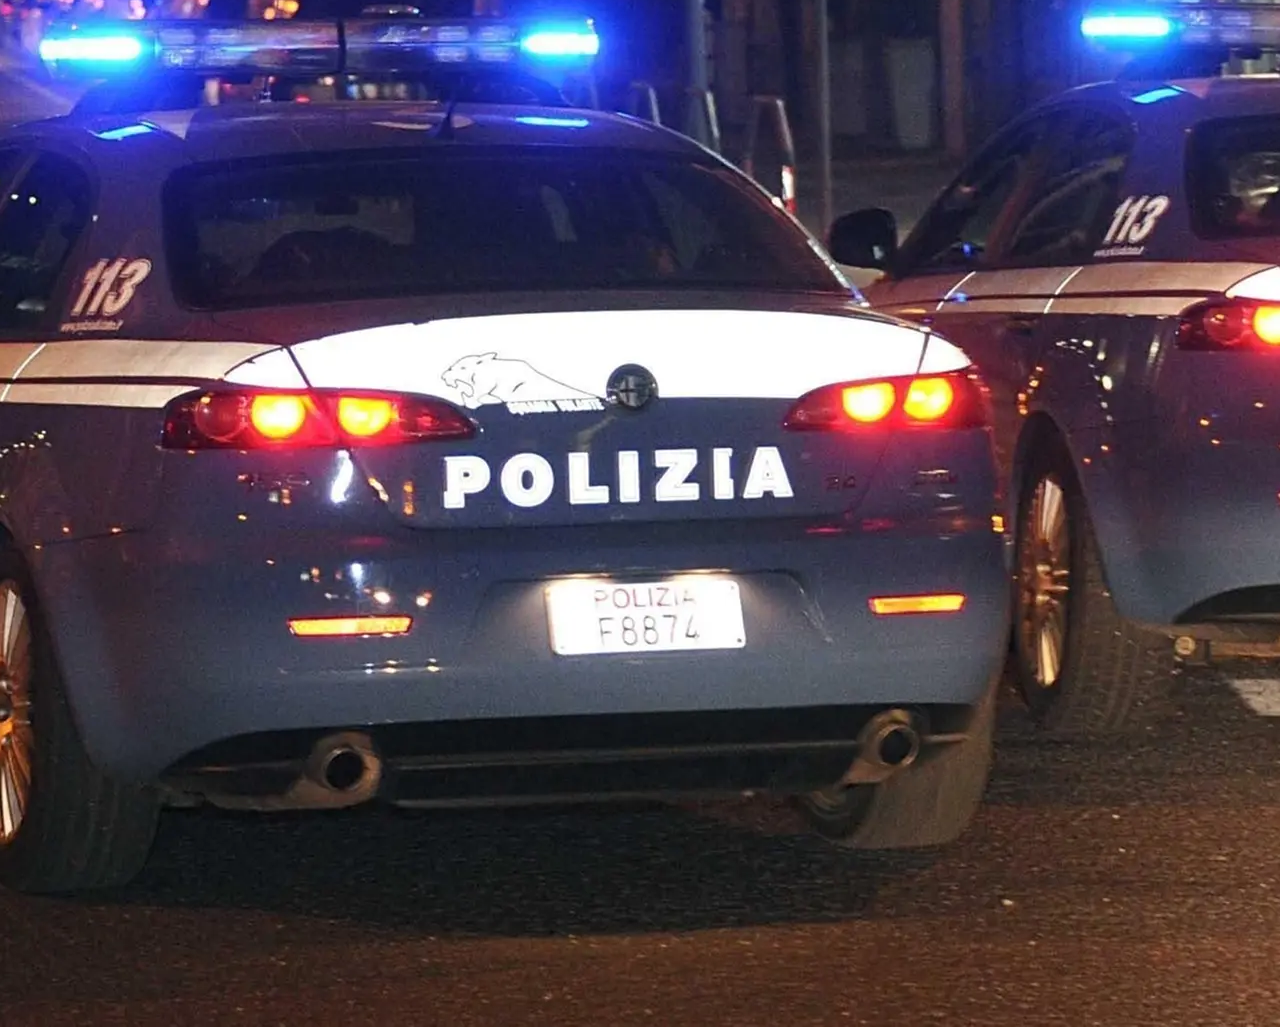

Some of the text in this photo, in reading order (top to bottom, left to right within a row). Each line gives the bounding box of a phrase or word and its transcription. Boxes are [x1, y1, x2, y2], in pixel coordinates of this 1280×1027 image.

[1102, 195, 1169, 244] 113
[70, 258, 152, 316] 113
[443, 446, 794, 508] POLIZIA
[595, 587, 697, 609] POLIZIA
[599, 615, 700, 646] F8874
